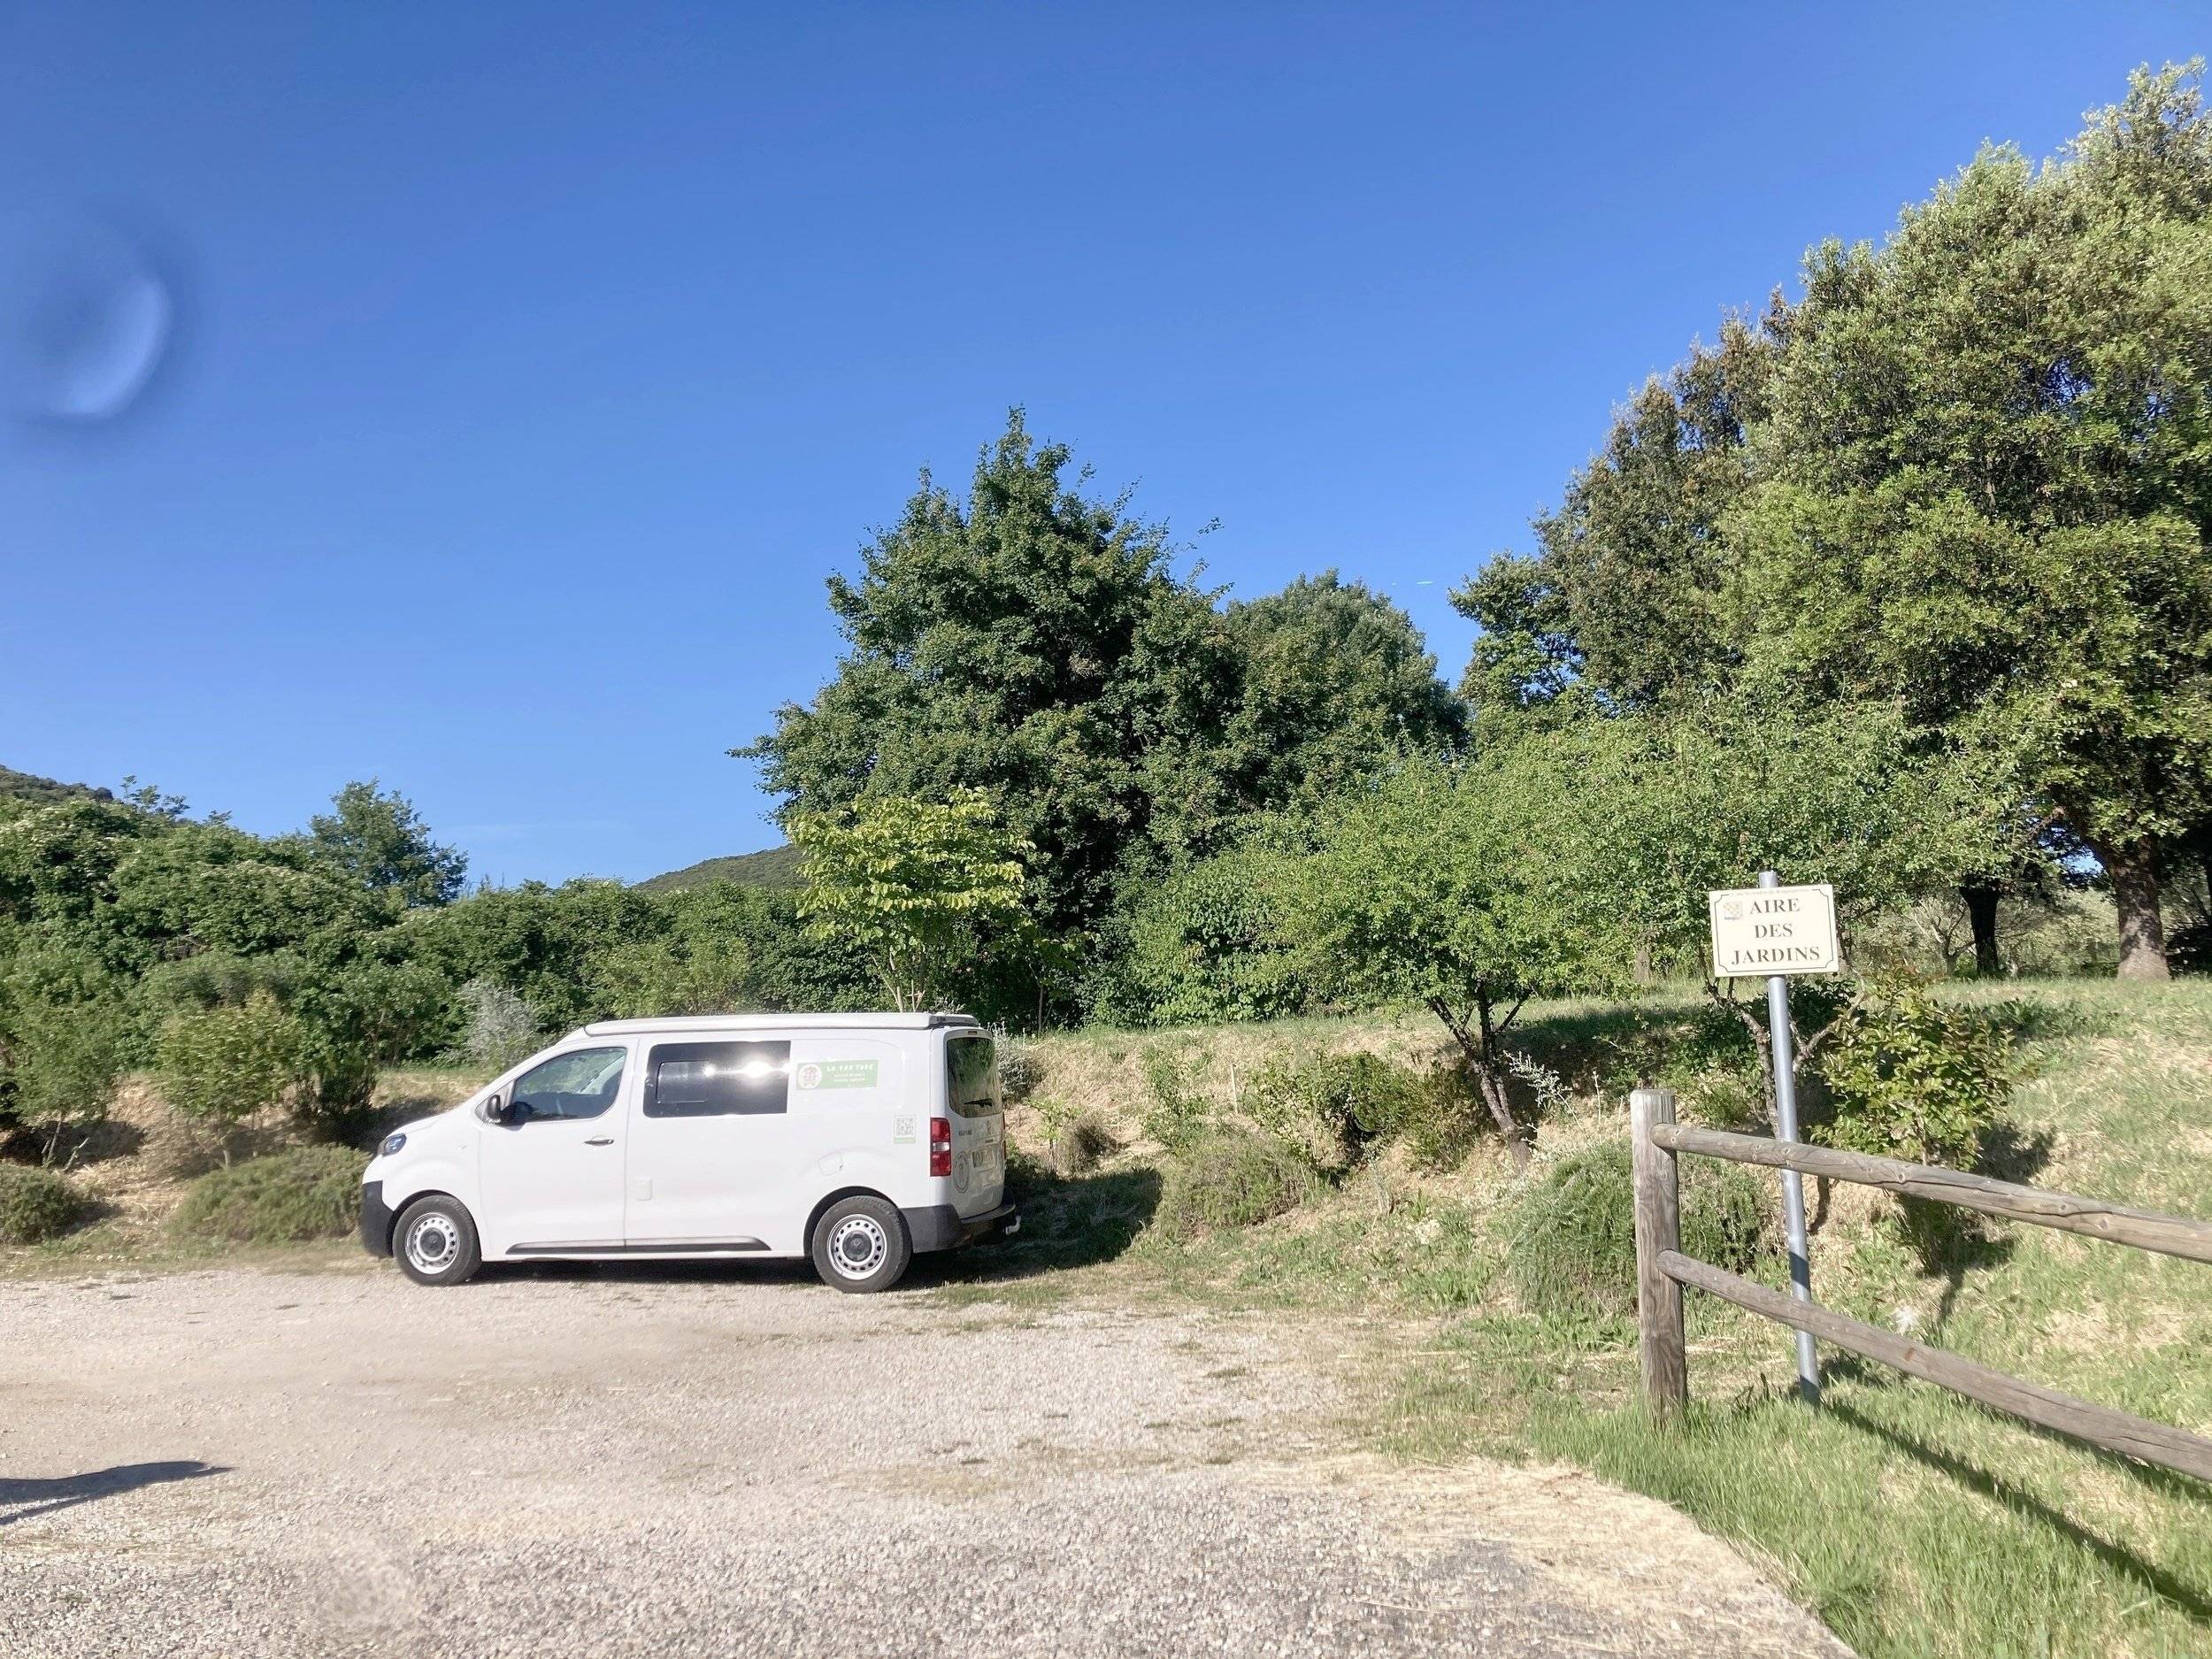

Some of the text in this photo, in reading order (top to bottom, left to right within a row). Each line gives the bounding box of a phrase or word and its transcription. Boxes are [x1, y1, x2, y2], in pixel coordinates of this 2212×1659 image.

[1750, 898, 1800, 914] AIRE
[1755, 923, 1793, 939] DES
[1732, 946, 1820, 965] JARDINS
